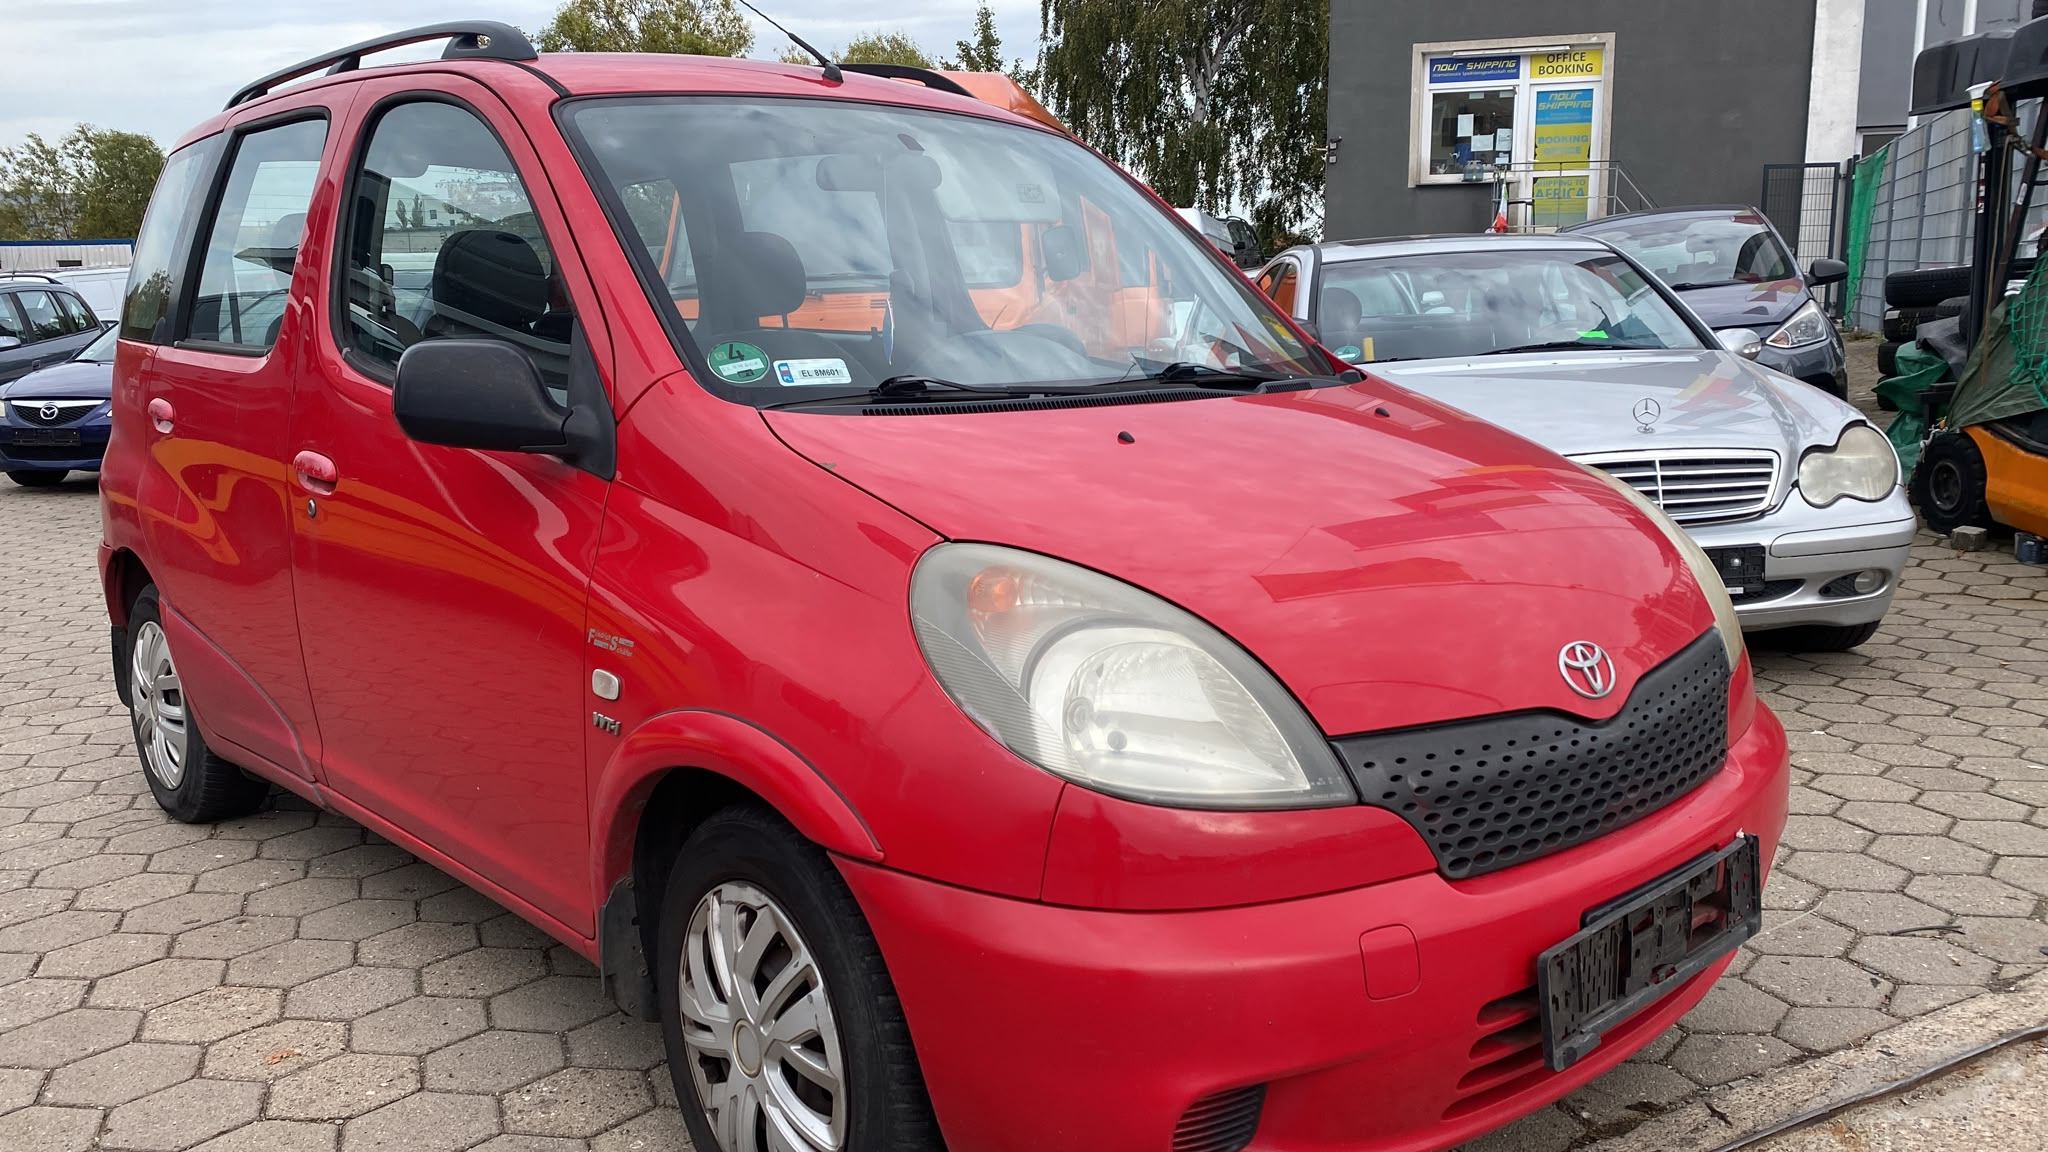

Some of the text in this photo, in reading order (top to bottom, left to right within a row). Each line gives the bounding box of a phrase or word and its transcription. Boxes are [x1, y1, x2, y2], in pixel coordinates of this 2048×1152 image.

[1547, 51, 1587, 64] OFFICE
[1466, 60, 1518, 70] SHIPPING
[1538, 63, 1594, 75] BOOKING
[1538, 100, 1593, 110] SHIPPING
[1538, 134, 1589, 144] BOOKING
[1575, 178, 1586, 186] TO
[1536, 187, 1585, 198] AFRICA
[729, 344, 744, 360] 4
[801, 369, 840, 377] EL 8M601
